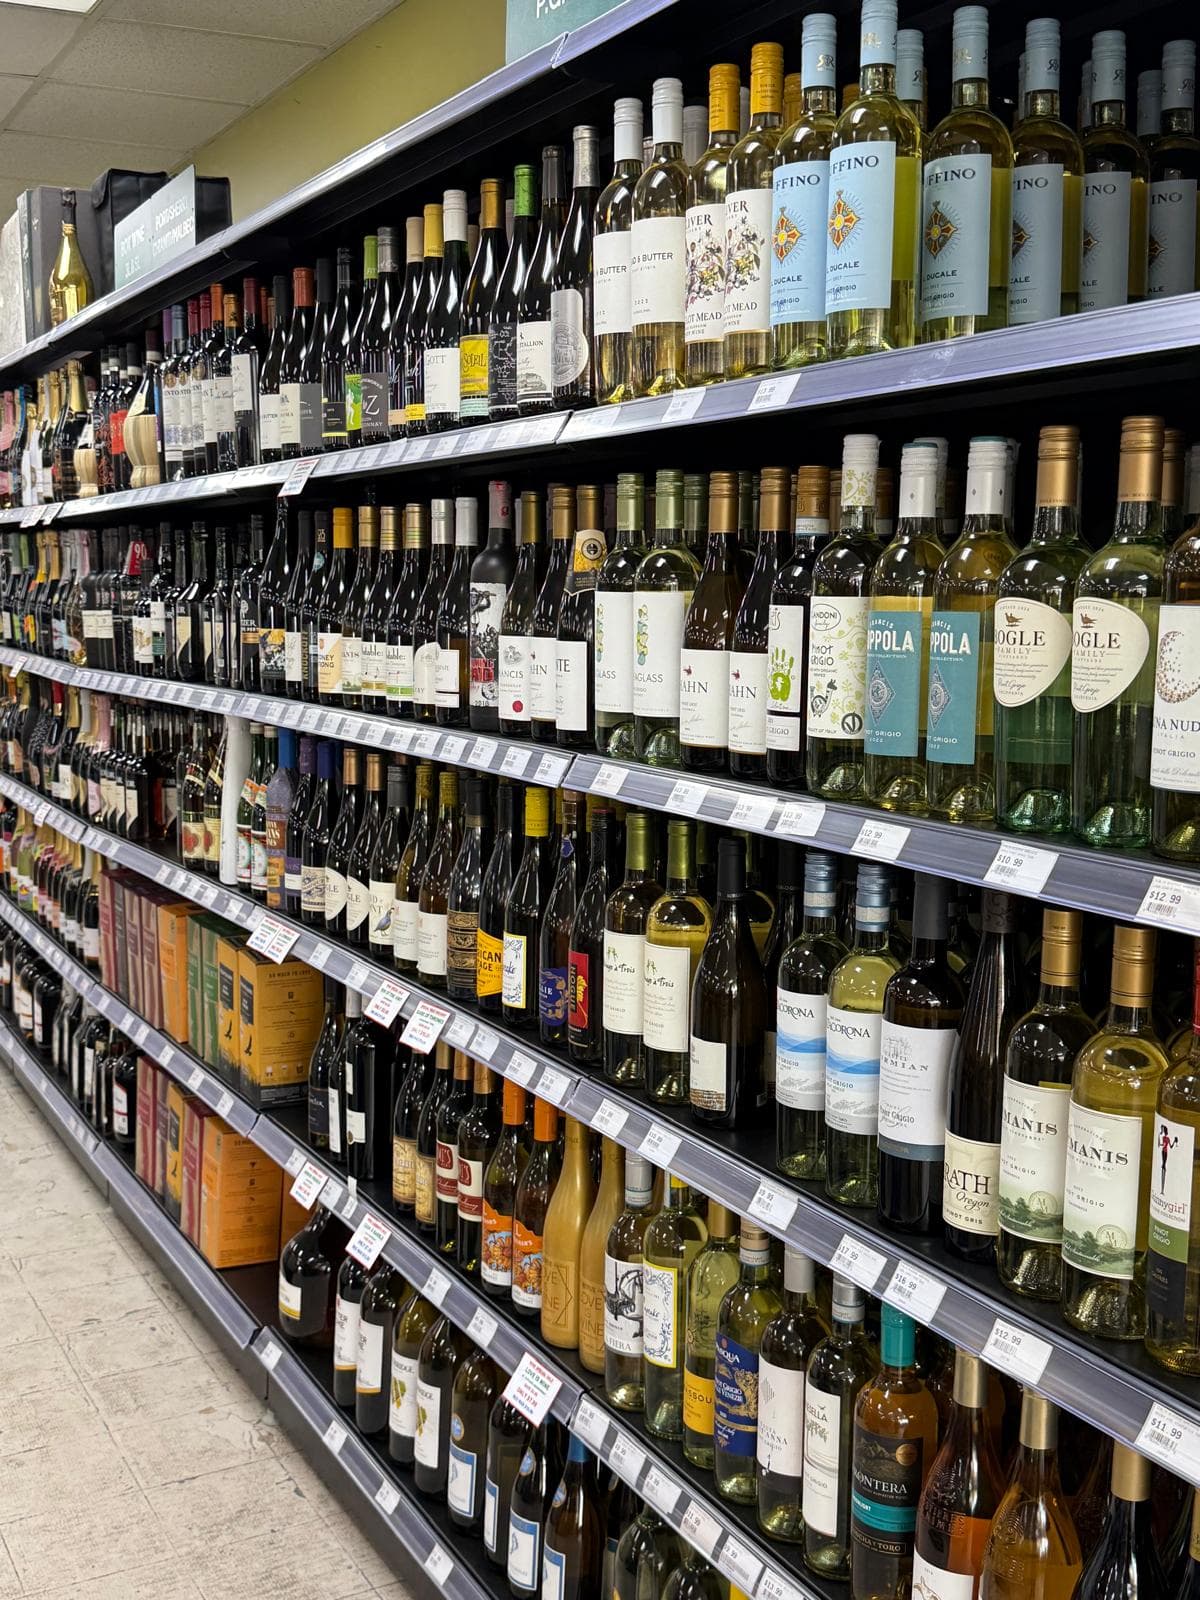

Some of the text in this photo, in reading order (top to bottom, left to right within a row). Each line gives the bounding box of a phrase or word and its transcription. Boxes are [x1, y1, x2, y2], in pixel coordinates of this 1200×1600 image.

[829, 155, 880, 174] FFINO
[773, 174, 821, 192] FFINO
[641, 252, 673, 262] BUTTER
[599, 265, 627, 276] BUTTER
[830, 260, 860, 273] DUCALE
[774, 274, 803, 287] DUCALE
[926, 269, 958, 281] DUCALE
[731, 301, 758, 312] MEAD
[695, 310, 723, 322] MEAD
[867, 630, 915, 653] PPOLA
[1167, 750, 1196, 758] GRIGIO
[778, 1003, 815, 1020] CORONA
[1010, 1164, 1036, 1176] GRIGIO
[956, 1190, 990, 1210] Oregon
[1077, 1194, 1105, 1208] GRIGIO
